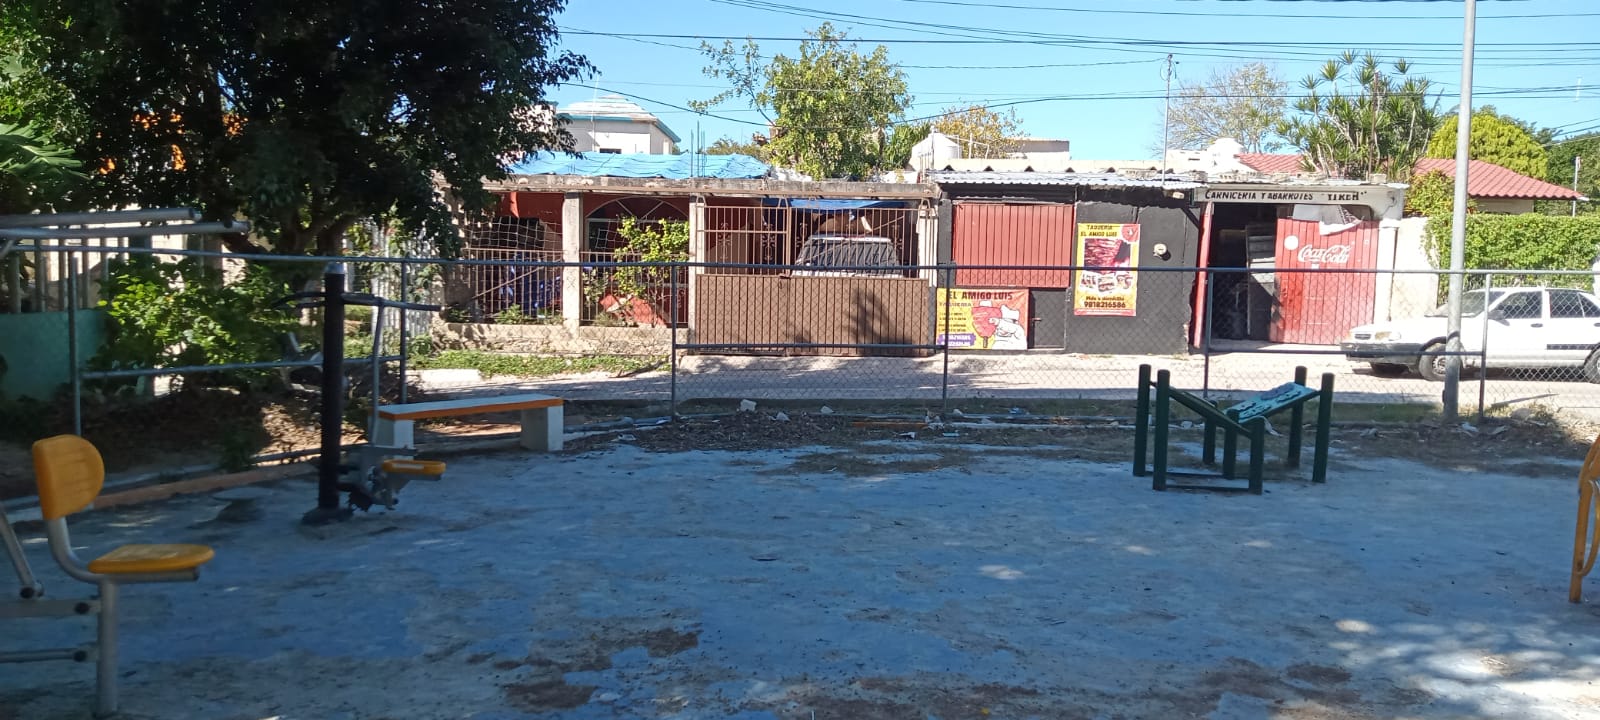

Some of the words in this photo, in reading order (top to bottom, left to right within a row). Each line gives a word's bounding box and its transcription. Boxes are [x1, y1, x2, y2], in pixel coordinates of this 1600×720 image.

[1205, 189, 1257, 200] CARNICERIA
[1261, 192, 1266, 200] Y
[1267, 192, 1314, 201] ABARROTES
[949, 291, 957, 299] EL
[961, 291, 992, 300] AMIGO
[994, 291, 1013, 301] LUIS
